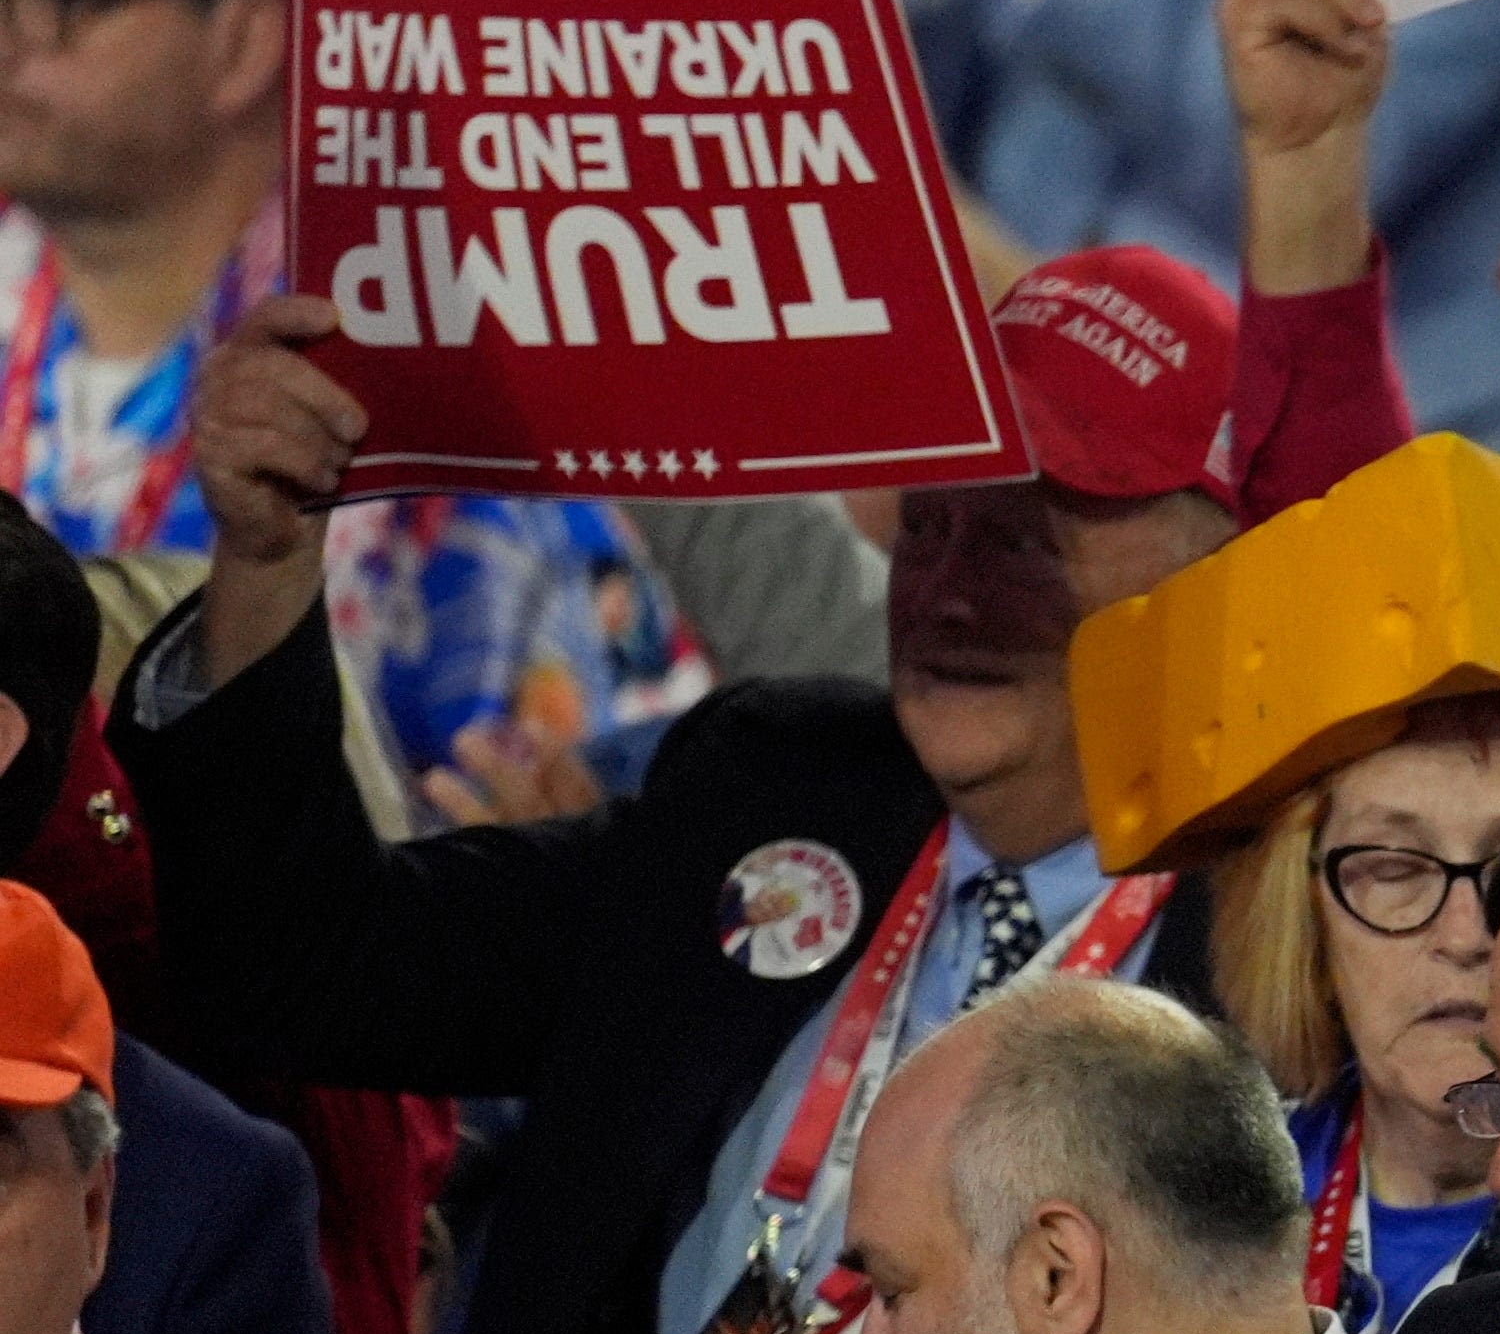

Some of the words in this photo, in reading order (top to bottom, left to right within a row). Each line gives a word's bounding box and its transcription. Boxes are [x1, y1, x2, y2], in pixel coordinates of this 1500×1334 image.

[315, 8, 464, 97] WAR
[482, 17, 854, 99] UKRAINE
[314, 107, 443, 191] THE
[460, 111, 629, 191] END
[639, 109, 877, 191] WILL
[331, 202, 891, 349] TRUMP
